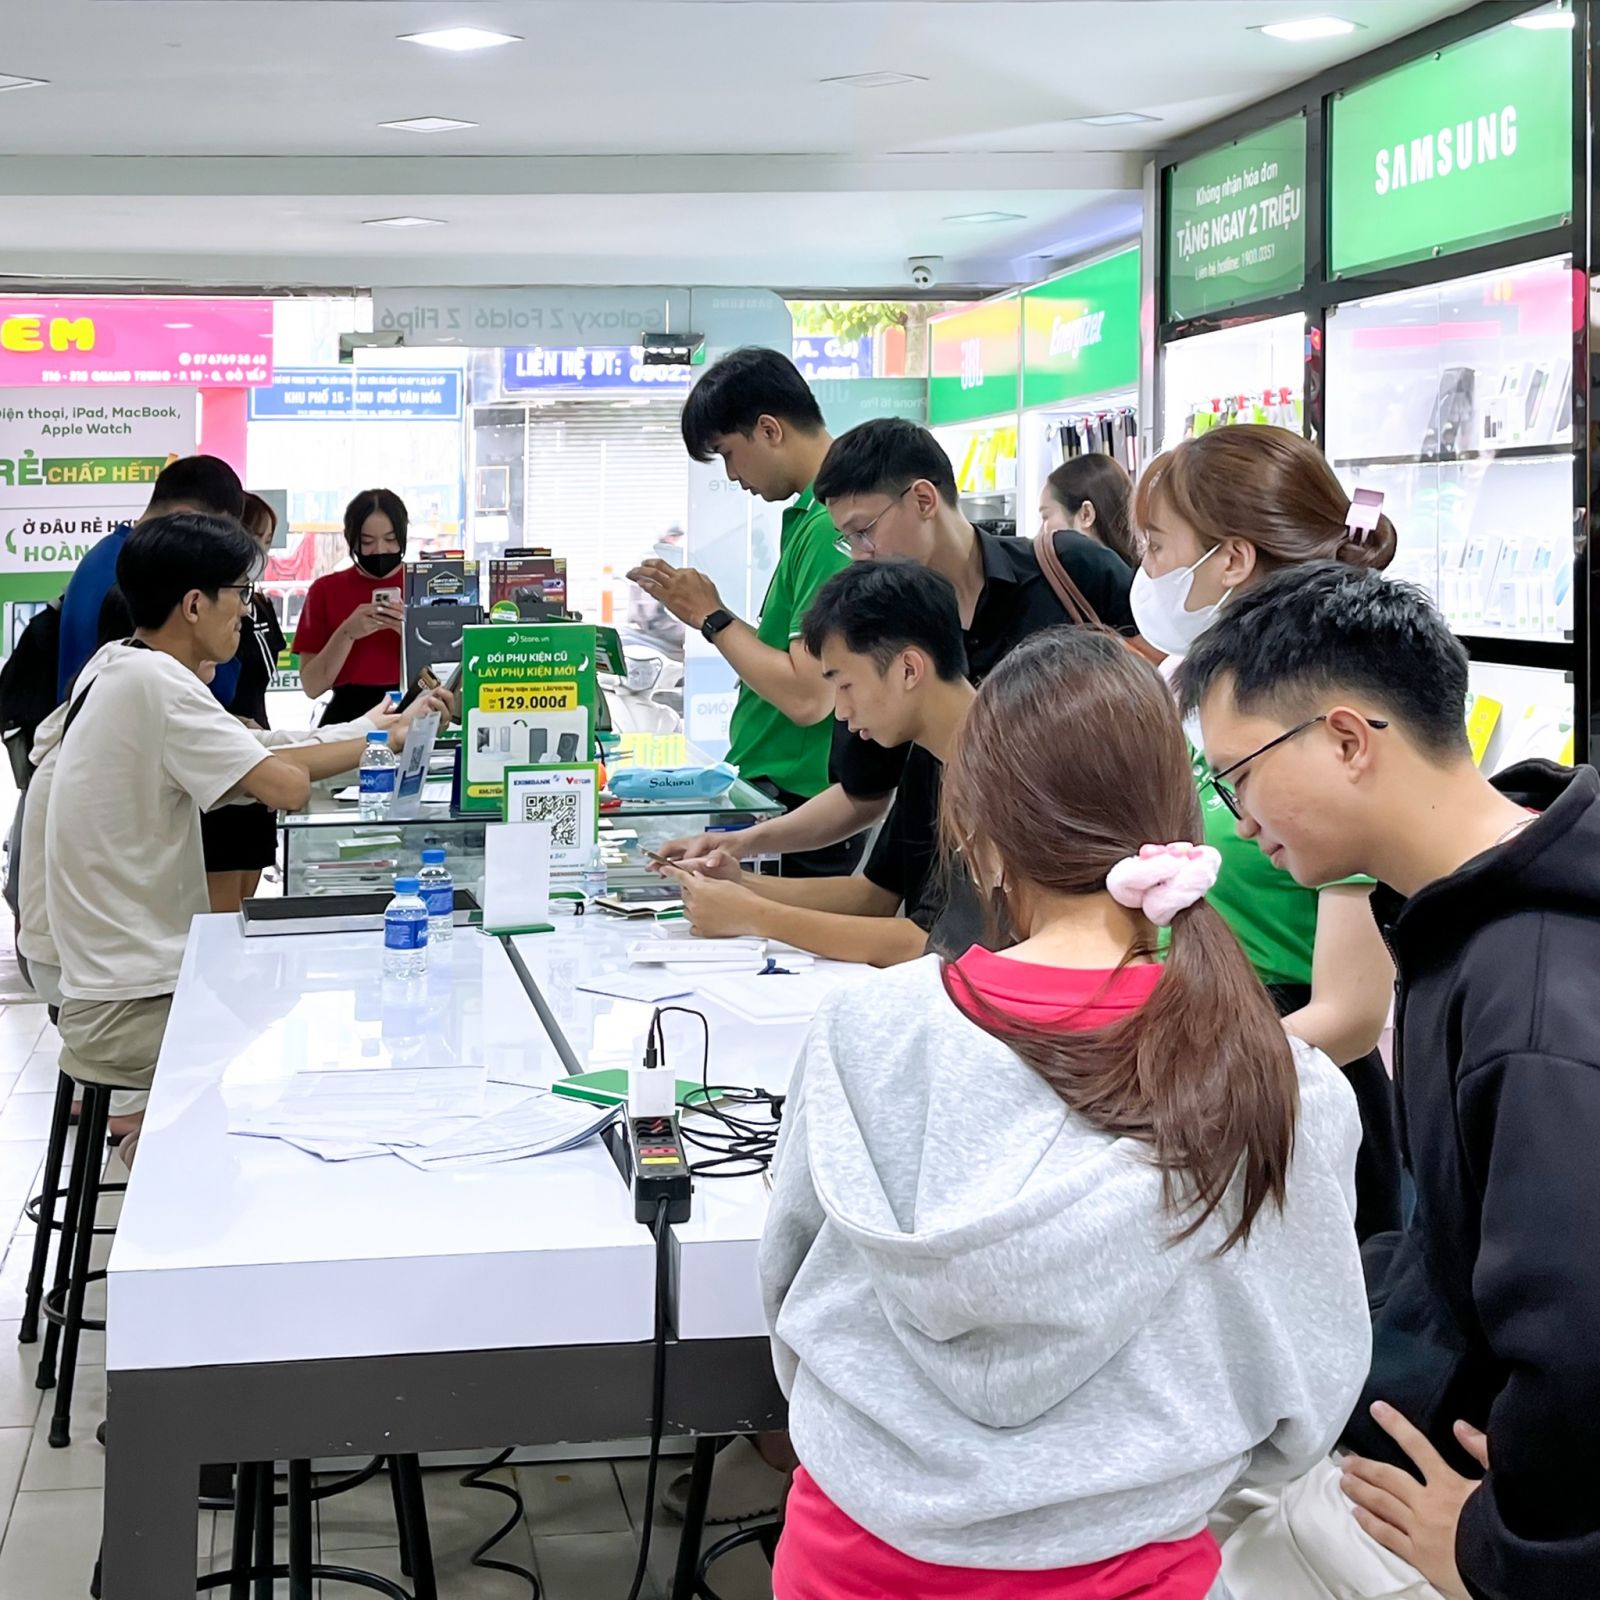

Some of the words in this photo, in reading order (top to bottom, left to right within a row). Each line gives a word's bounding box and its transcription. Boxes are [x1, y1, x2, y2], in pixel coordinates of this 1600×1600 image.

[1375, 105, 1517, 195] SAMSUNG
[1196, 184, 1221, 208] Không
[1221, 174, 1242, 198] nhận
[1243, 167, 1259, 189] hóa
[1261, 161, 1278, 182] đơn
[1176, 220, 1209, 262] TẶNG
[1211, 206, 1247, 247] NGAY
[1249, 203, 1258, 235] 2
[1259, 184, 1301, 231] TRIỆU
[1049, 307, 1105, 359] Energizer
[516, 347, 557, 377] LIÊN
[561, 347, 586, 380] HỆ
[0, 407, 24, 422] iện
[28, 407, 69, 421] thoại,
[73, 407, 108, 420] iPad,
[112, 407, 181, 420] MacBook,
[41, 424, 83, 437] Apple
[86, 423, 132, 435] Watch
[48, 461, 107, 483] CHẤP
[23, 519, 35, 534] Ở
[40, 519, 76, 534] ĐÂU
[81, 517, 103, 533] RẺ
[506, 653, 527, 664] PHỤ
[529, 651, 552, 663] KIỆN
[554, 651, 568, 661] CŨ
[271, 672, 300, 687] HẾT
[501, 667, 525, 679] PHỤ
[527, 665, 552, 678] KIỆN
[554, 665, 576, 676] MỚI
[498, 695, 567, 709] 129.000đ
[650, 777, 694, 789] Sakurai
